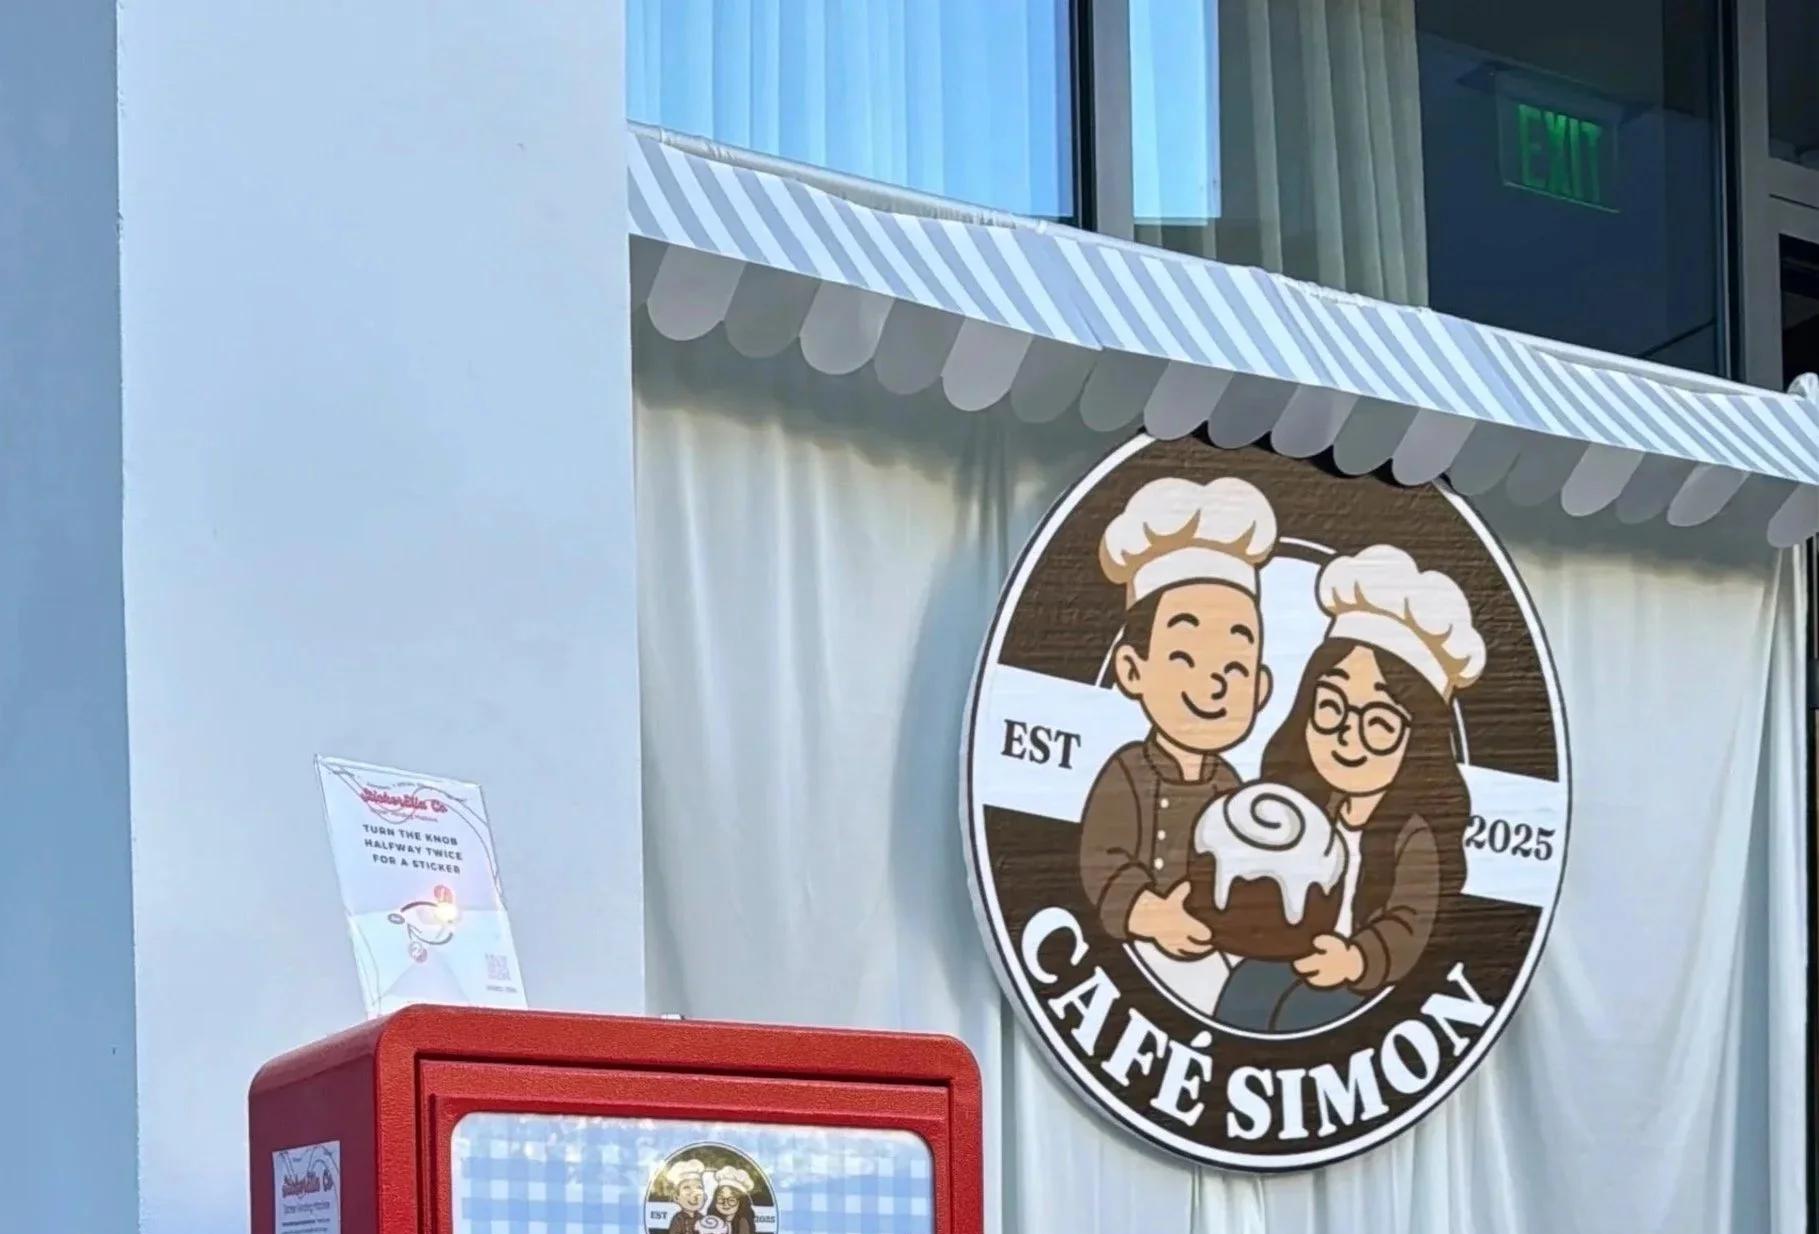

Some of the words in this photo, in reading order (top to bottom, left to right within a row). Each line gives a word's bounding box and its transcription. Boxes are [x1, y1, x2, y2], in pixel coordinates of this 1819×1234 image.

[1518, 104, 1602, 202] EXIT
[1001, 719, 1082, 771] EST
[362, 824, 395, 837] TURN
[399, 829, 421, 840] THE
[425, 833, 458, 846] KNOB
[364, 838, 421, 854] HALFWAY
[426, 847, 463, 861] TWICE
[1464, 814, 1557, 862] 2025
[372, 854, 396, 865] FOR
[400, 858, 408, 867] A
[412, 860, 461, 875] STICKER
[1019, 905, 1213, 1127] CAFÉ
[1226, 962, 1496, 1141] SIMON
[650, 1211, 668, 1220] EST
